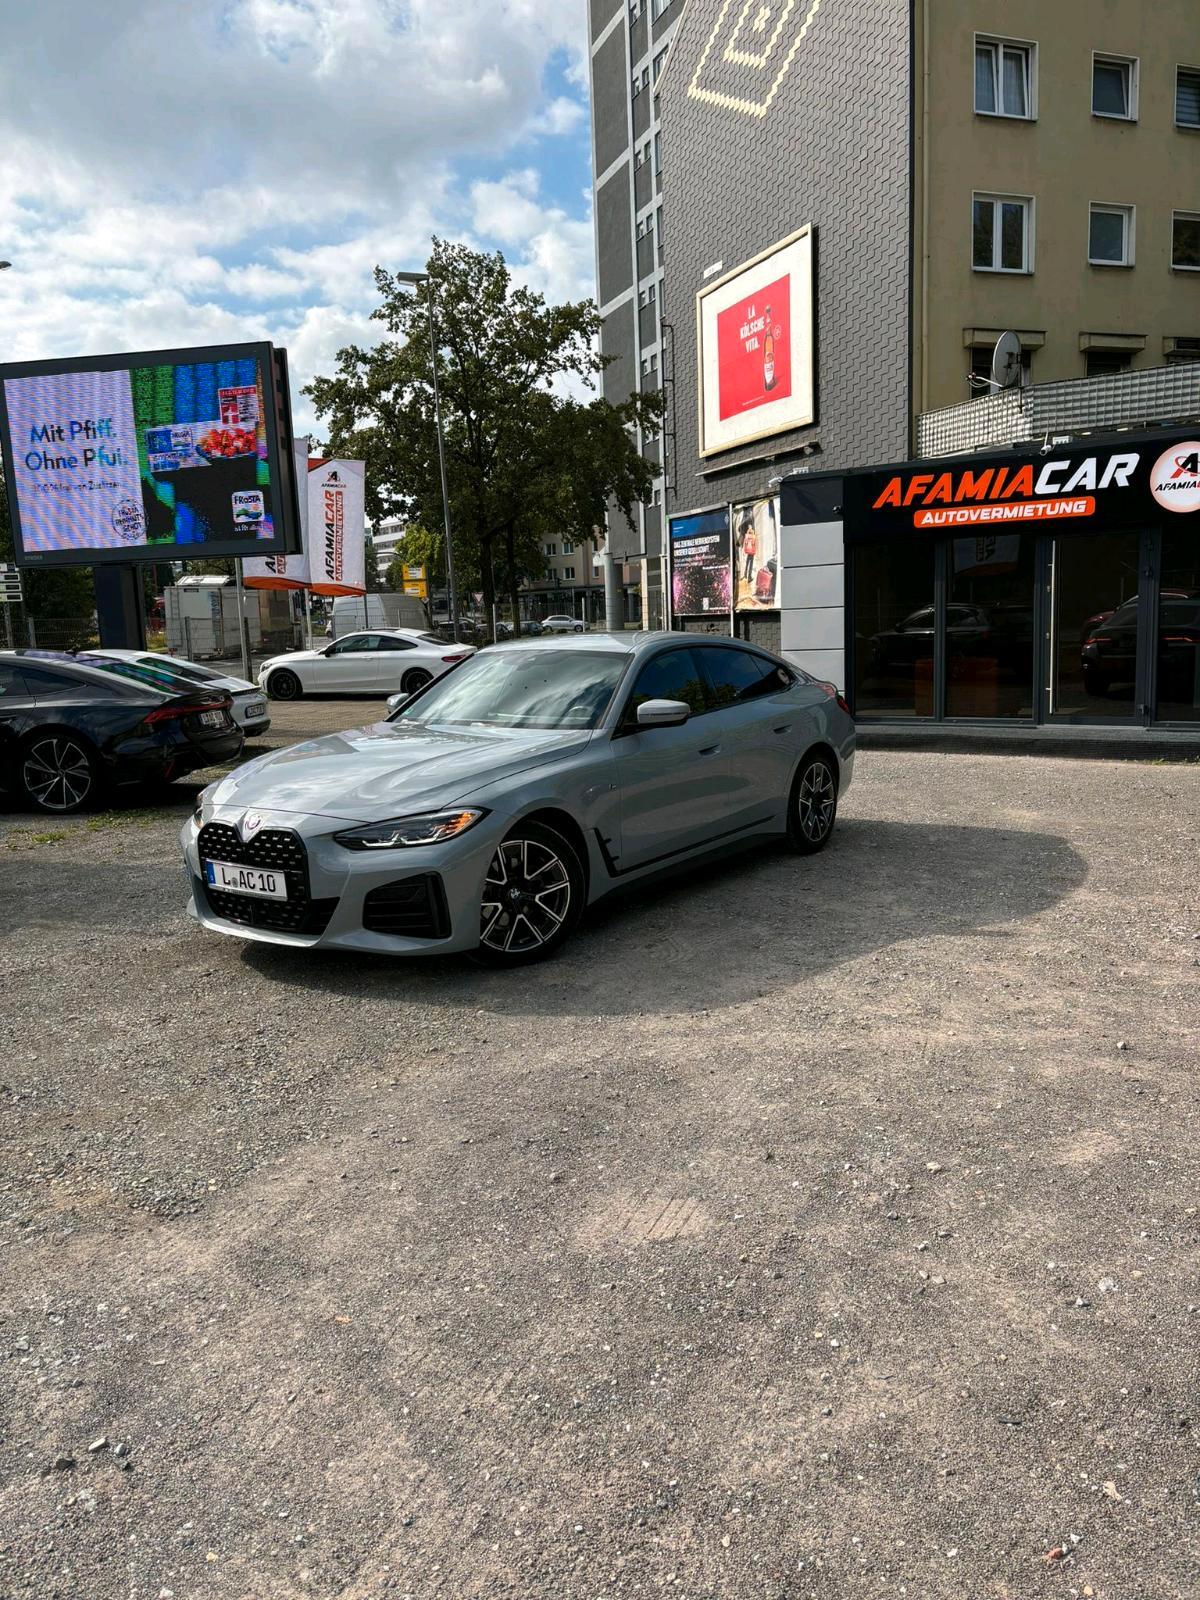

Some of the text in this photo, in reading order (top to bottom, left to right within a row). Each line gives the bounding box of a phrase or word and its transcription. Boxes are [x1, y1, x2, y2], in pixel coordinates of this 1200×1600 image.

[748, 304, 756, 320] LA
[740, 316, 765, 339] KÖLSCHE
[31, 424, 65, 443] Mit
[25, 451, 78, 470] Ohne
[872, 453, 1140, 509] AFAMIACAR
[1155, 480, 1200, 492] AFAMIA
[921, 500, 1087, 525] AUTOVERMIETUNG
[324, 490, 336, 581] AFAMIACAR
[221, 867, 276, 892] L AC 10
